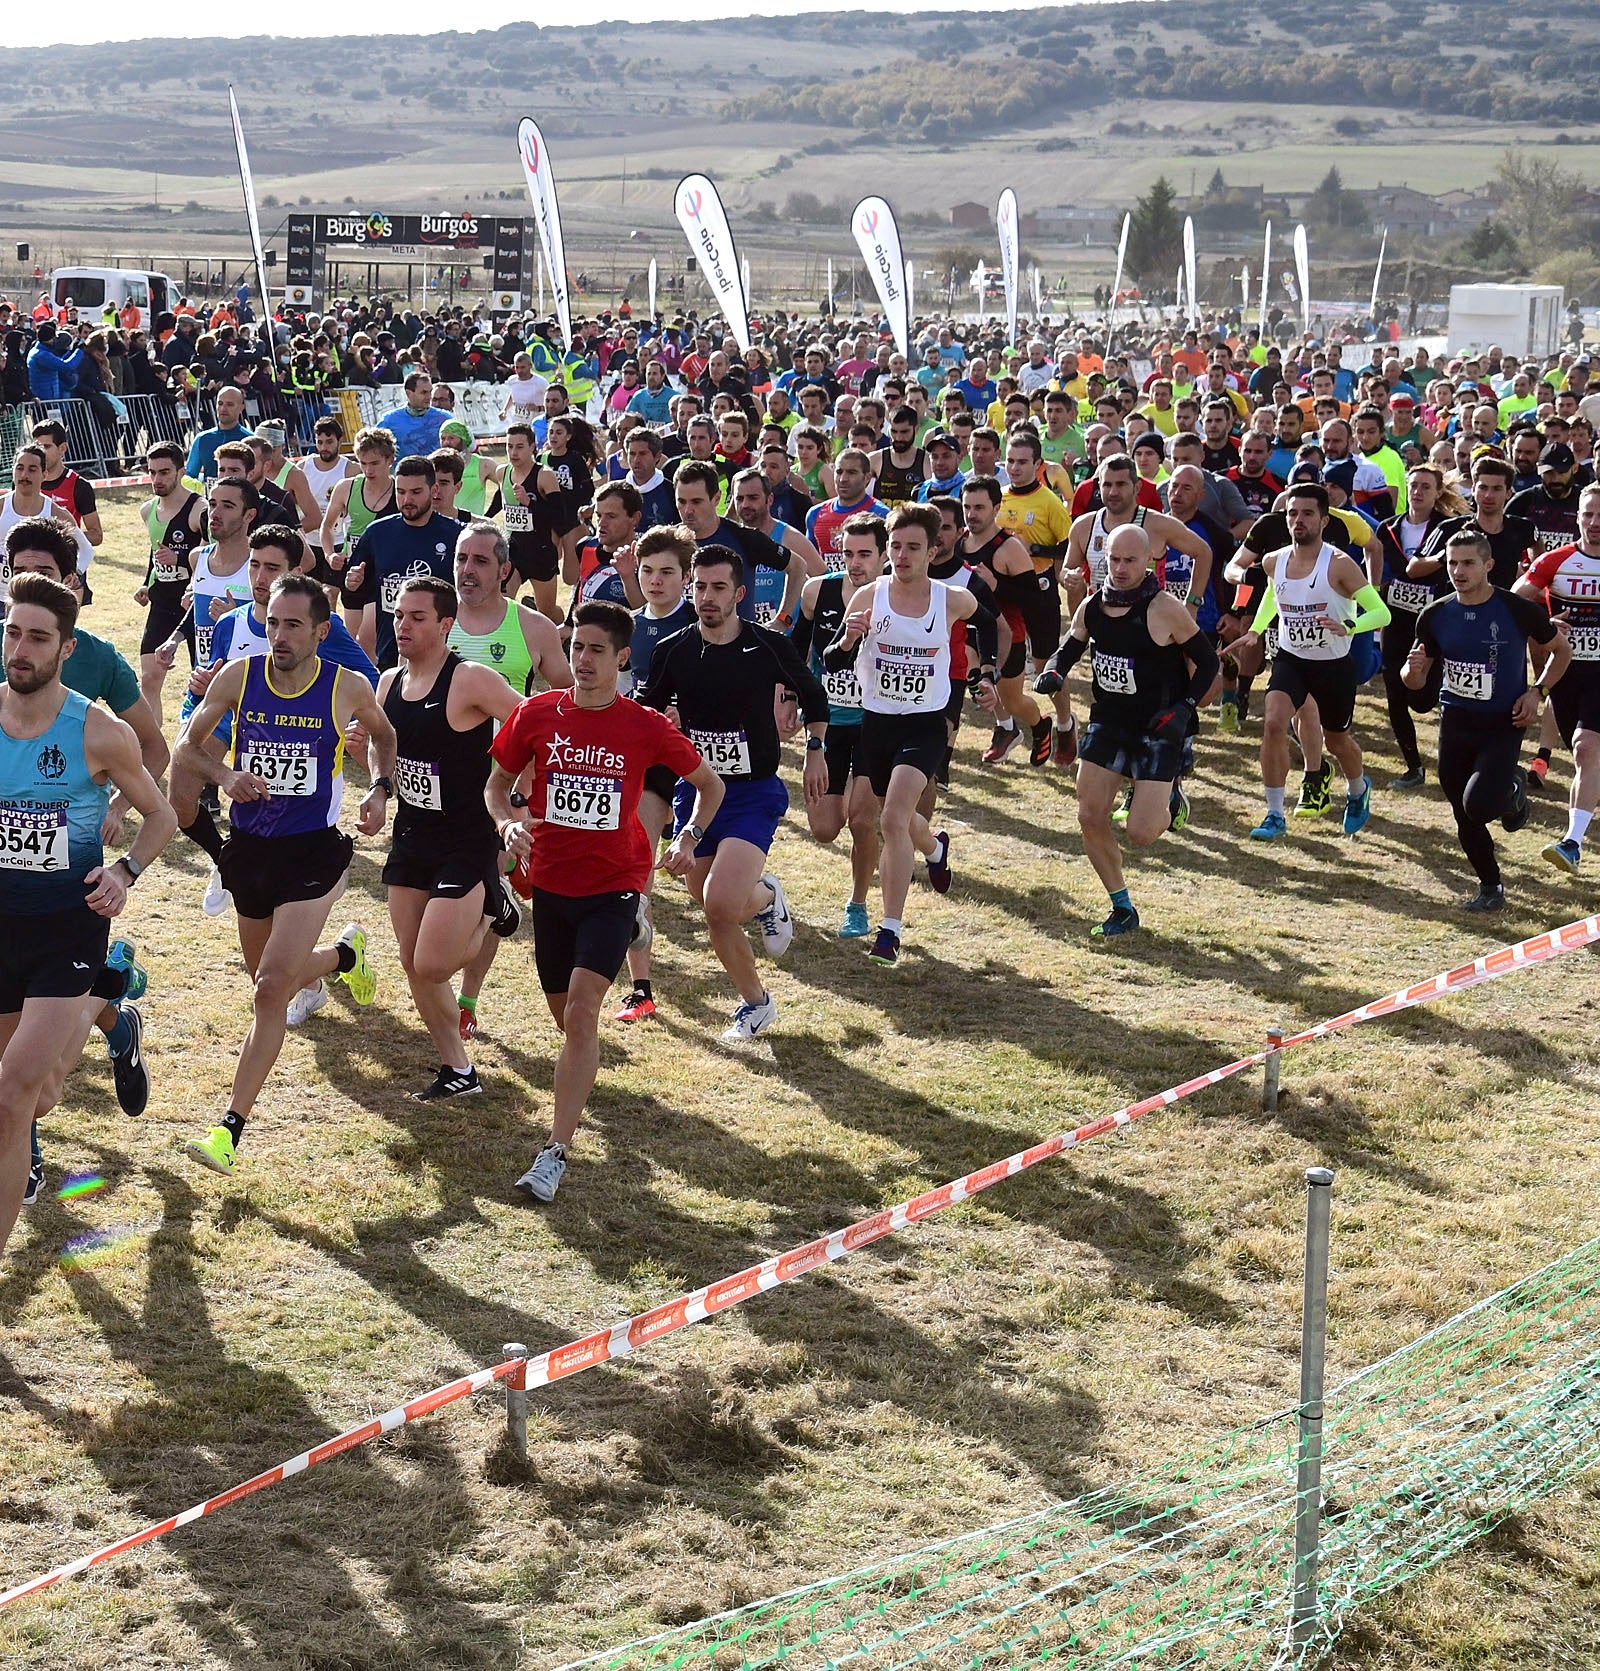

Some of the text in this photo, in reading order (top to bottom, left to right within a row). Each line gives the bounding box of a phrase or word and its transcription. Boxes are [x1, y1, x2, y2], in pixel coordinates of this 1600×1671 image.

[326, 211, 393, 242] Burgos
[421, 212, 479, 239] Burgos
[392, 246, 416, 255] META
[505, 512, 528, 525] 6665
[1545, 540, 1570, 551] 64
[1392, 588, 1427, 606] 6524
[755, 611, 771, 624] 28
[1288, 626, 1325, 642] 6147
[913, 646, 928, 656] RUN
[880, 659, 930, 671] DIPUTACIÓN
[880, 666, 929, 677] BURGOS
[1095, 663, 1128, 684] 6458
[880, 673, 926, 693] 6150
[245, 710, 323, 729] C.A. IRANZU
[248, 739, 310, 750] DIPUTACIÓN
[248, 747, 310, 757] BURGOS
[564, 745, 625, 770] califas
[692, 741, 741, 763] 6154
[249, 755, 308, 781] 6375
[396, 756, 431, 768] PUTACIÓN
[397, 763, 432, 775] URGOS
[552, 772, 615, 785] DIPUTACIÓN
[265, 783, 285, 792] Caja
[553, 779, 615, 792] BURGOS
[20, 799, 33, 809] DE
[35, 800, 70, 810] DUERO
[553, 788, 611, 816] 6678
[552, 812, 588, 825] iberCaja
